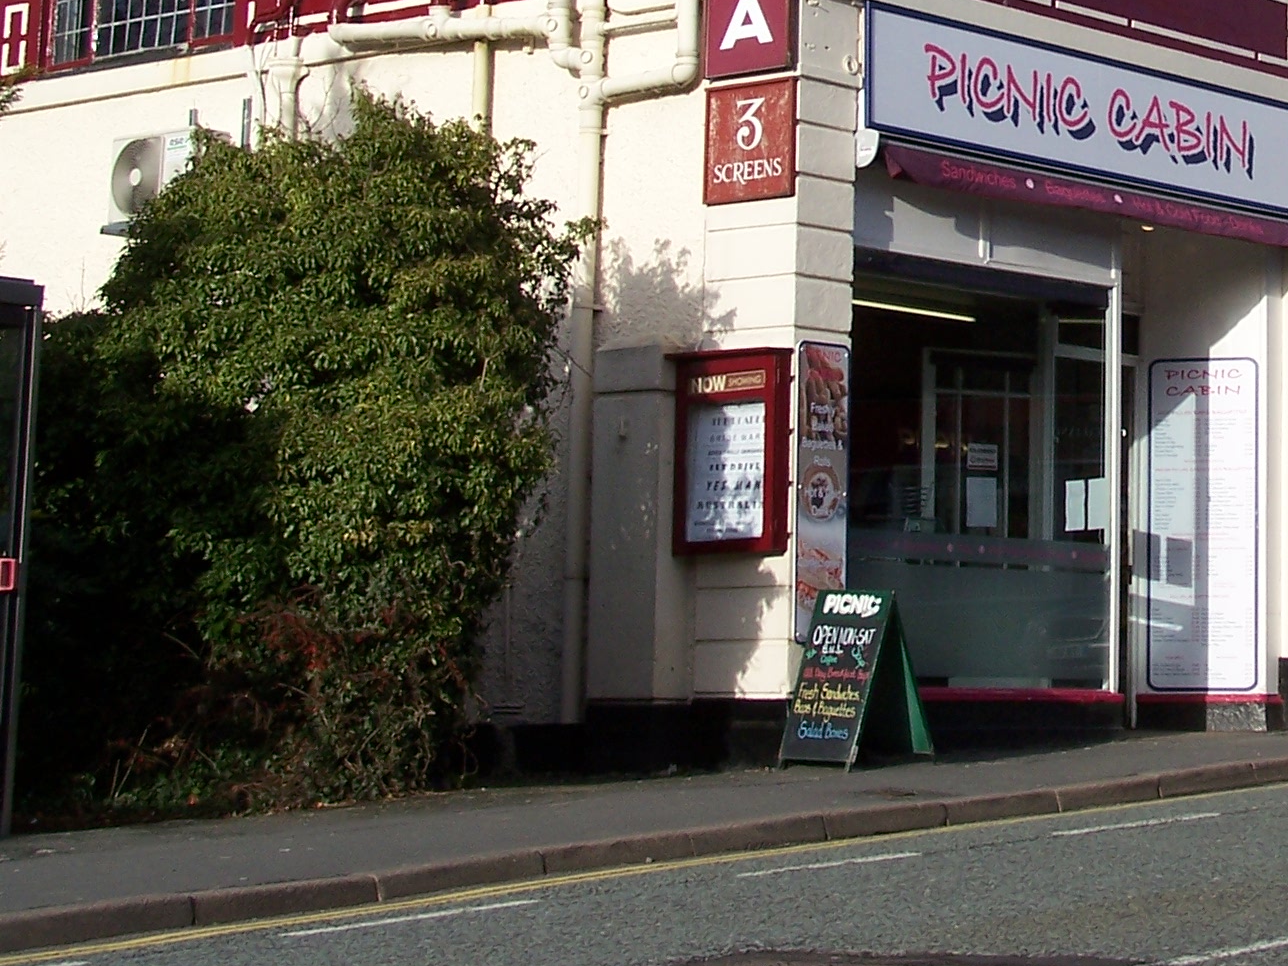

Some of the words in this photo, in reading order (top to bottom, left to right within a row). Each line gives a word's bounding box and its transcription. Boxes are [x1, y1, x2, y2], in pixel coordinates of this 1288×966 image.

[924, 43, 1095, 139] PICNIC
[1107, 88, 1254, 180] CABIN
[736, 97, 765, 150] 3
[713, 157, 782, 185] SCREENS
[940, 160, 1016, 189] Sandwiches
[691, 375, 726, 393] NOW
[728, 375, 762, 387] SHOWING
[1164, 369, 1242, 380] PICNIC
[1166, 385, 1240, 396] CABIN
[706, 480, 727, 491] YES
[734, 480, 761, 491] MAN
[823, 594, 882, 618] PICNIC
[812, 625, 839, 645] OPEN
[798, 682, 819, 700] Fresh
[798, 720, 824, 739] Salad
